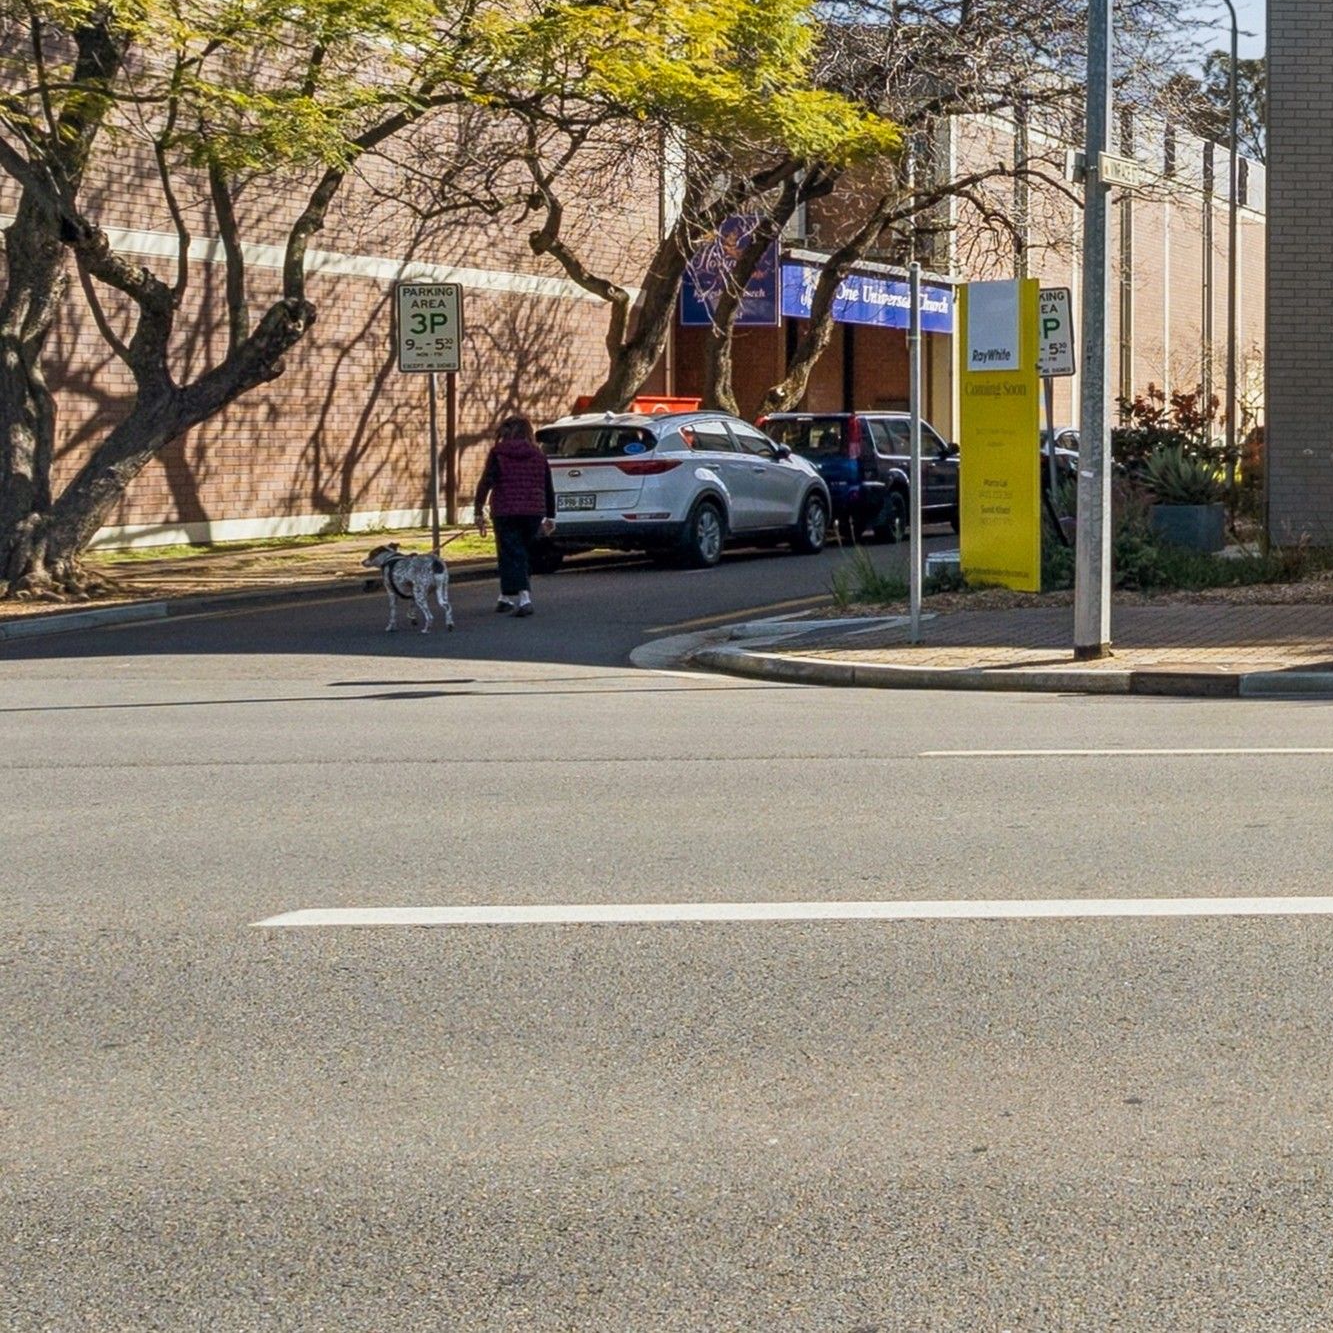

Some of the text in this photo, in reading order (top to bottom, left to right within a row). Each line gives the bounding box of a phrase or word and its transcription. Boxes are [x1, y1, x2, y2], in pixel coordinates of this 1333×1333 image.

[402, 287, 454, 297] PARKING
[863, 285, 911, 309] Universa
[1039, 291, 1065, 302] KING
[410, 299, 446, 308] AREA
[1040, 304, 1058, 314] EA
[410, 313, 448, 334] 3P
[1042, 318, 1060, 340] P
[965, 381, 1027, 399] Coming Soon
